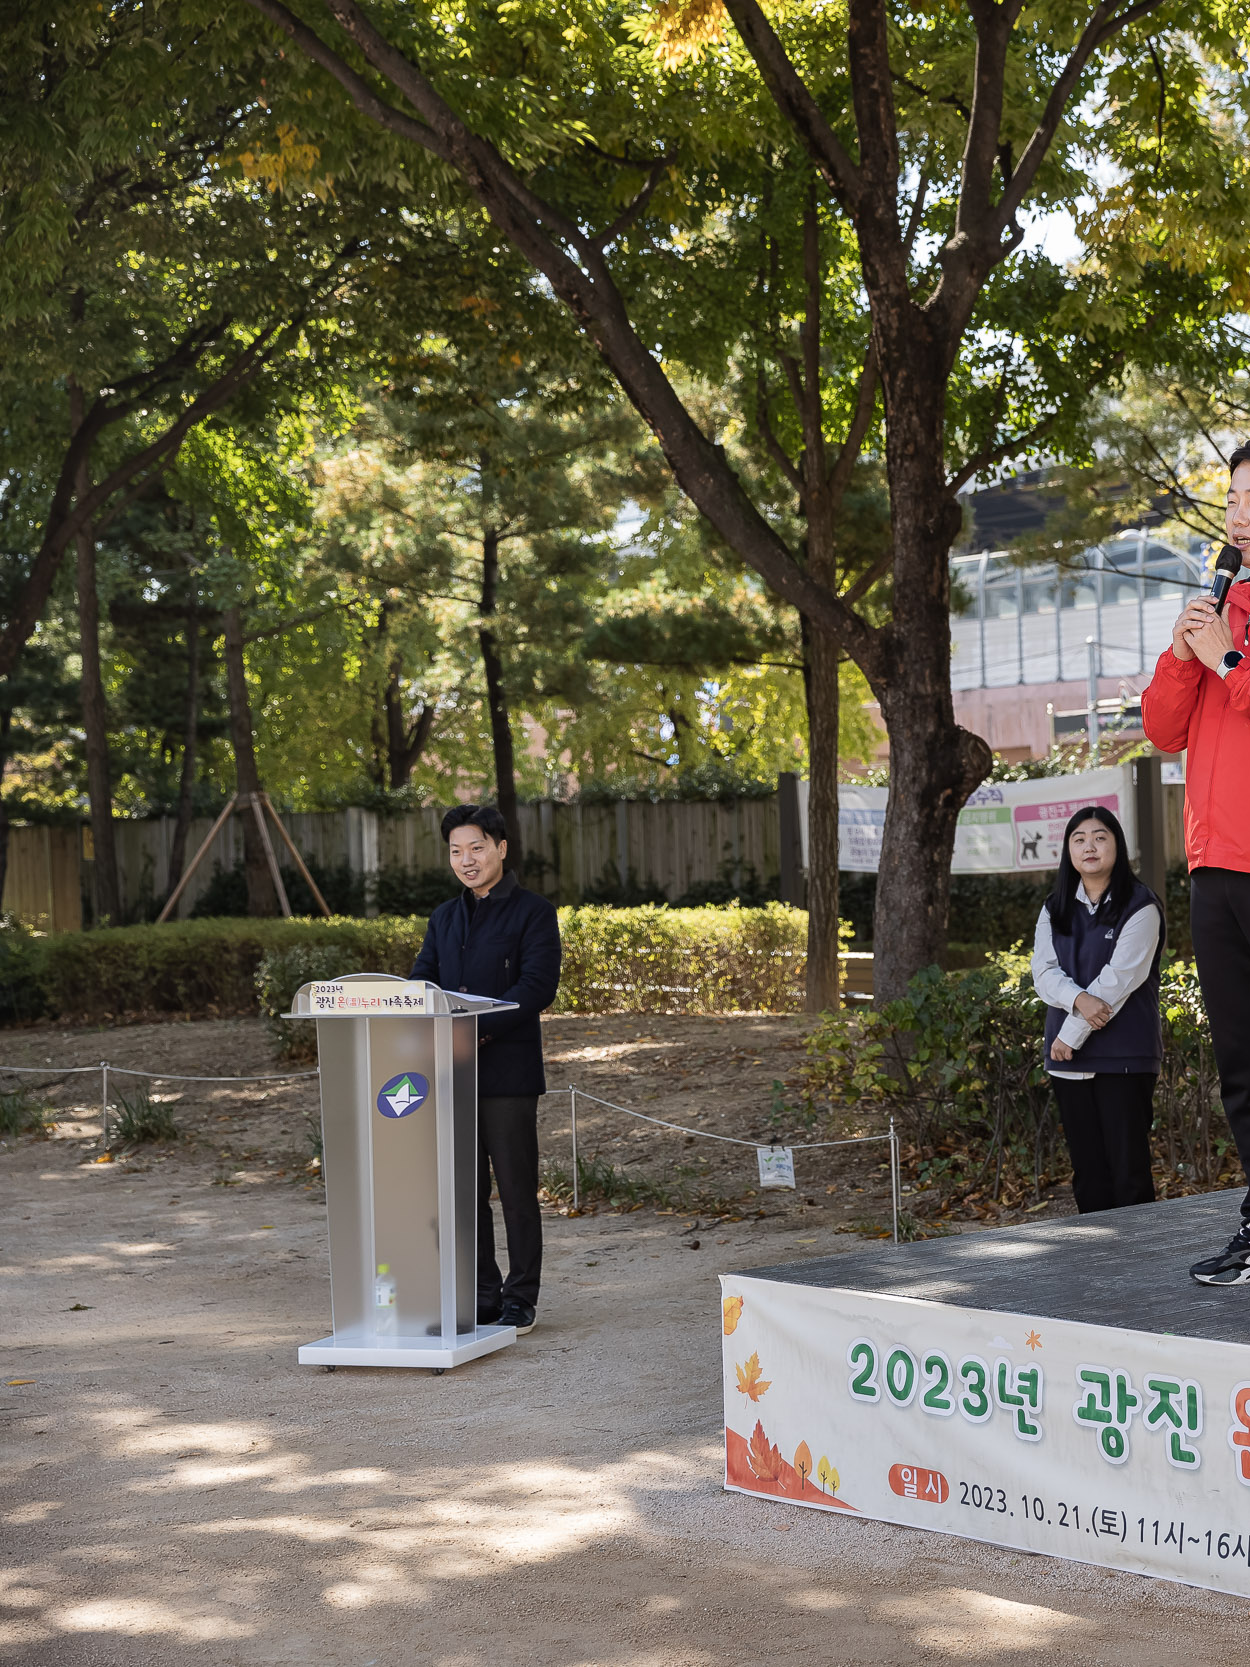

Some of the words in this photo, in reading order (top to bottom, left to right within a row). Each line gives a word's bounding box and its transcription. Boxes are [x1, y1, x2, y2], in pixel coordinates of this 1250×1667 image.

[315, 985, 343, 994] 2023년
[315, 996, 335, 1009] 광진
[383, 995, 424, 1009] 가족축제
[850, 1343, 1040, 1435] 2023년
[1076, 1368, 1200, 1463] 광진
[899, 1467, 943, 1503] 일시
